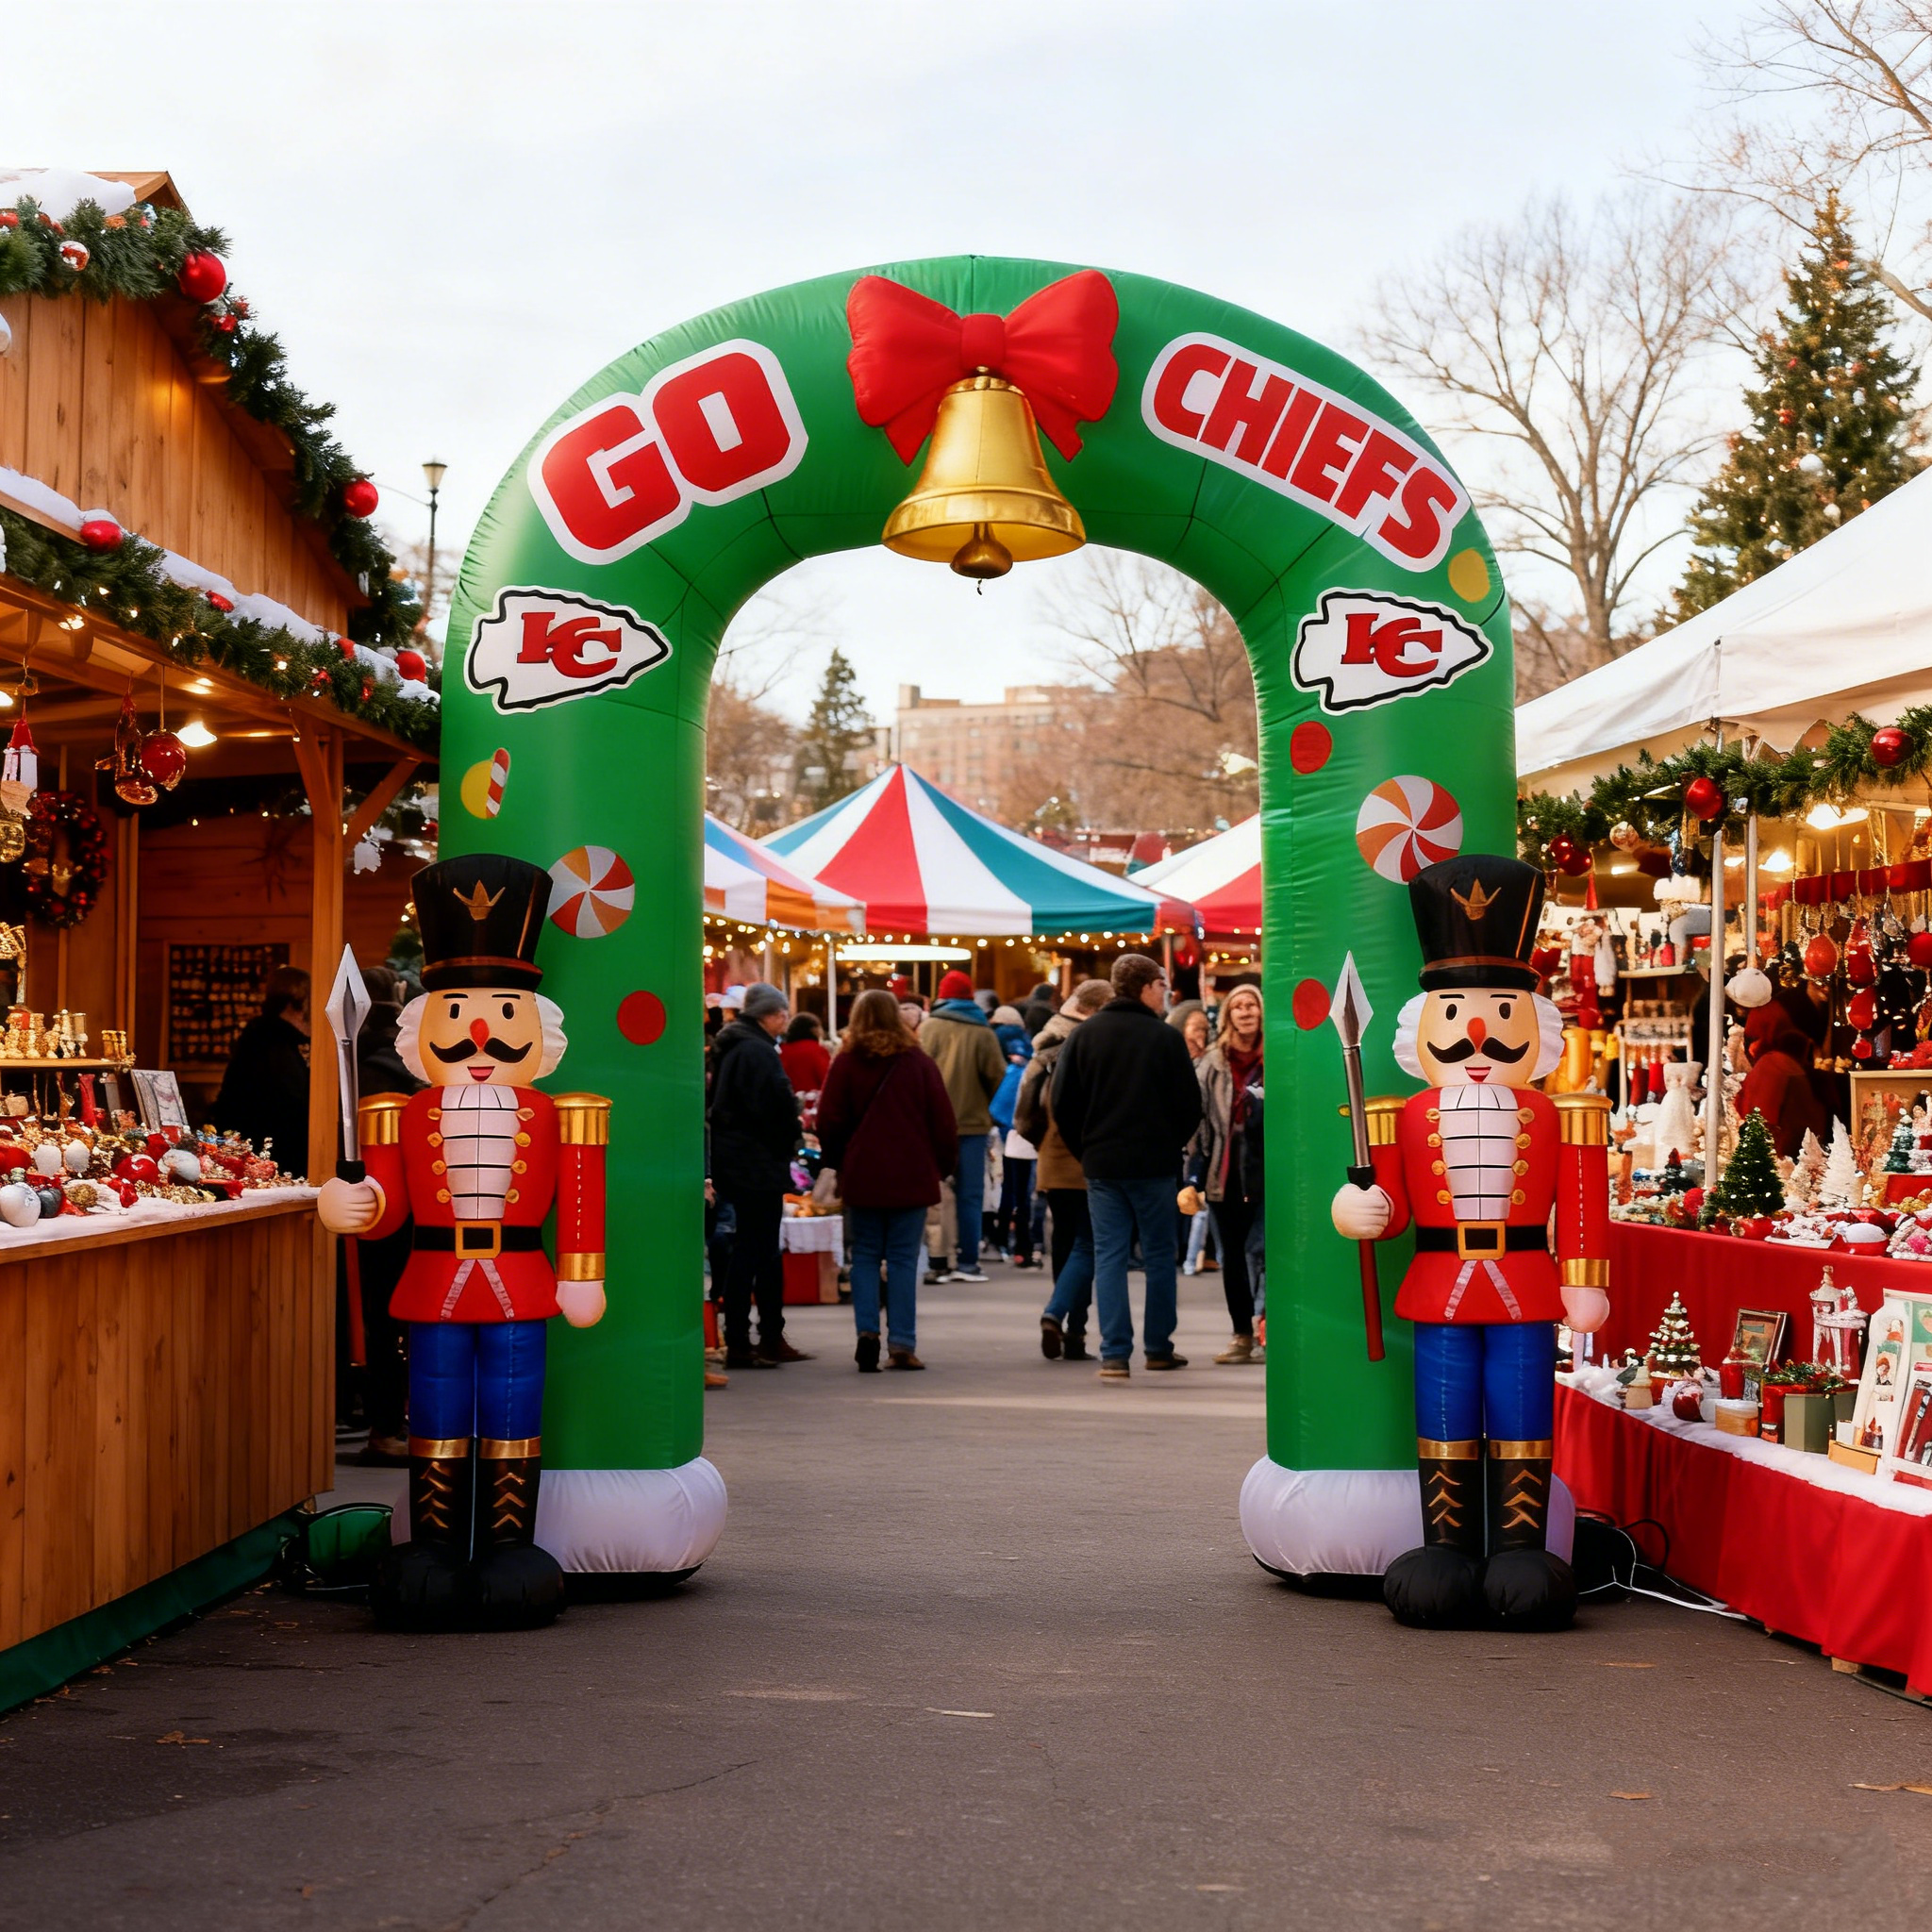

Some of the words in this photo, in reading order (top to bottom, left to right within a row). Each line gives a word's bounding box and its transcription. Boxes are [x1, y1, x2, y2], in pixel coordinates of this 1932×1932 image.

[541, 352, 791, 550] GO
[1153, 343, 1457, 559] CHIEFS
[517, 611, 622, 678] KC
[1341, 612, 1442, 678] KC
